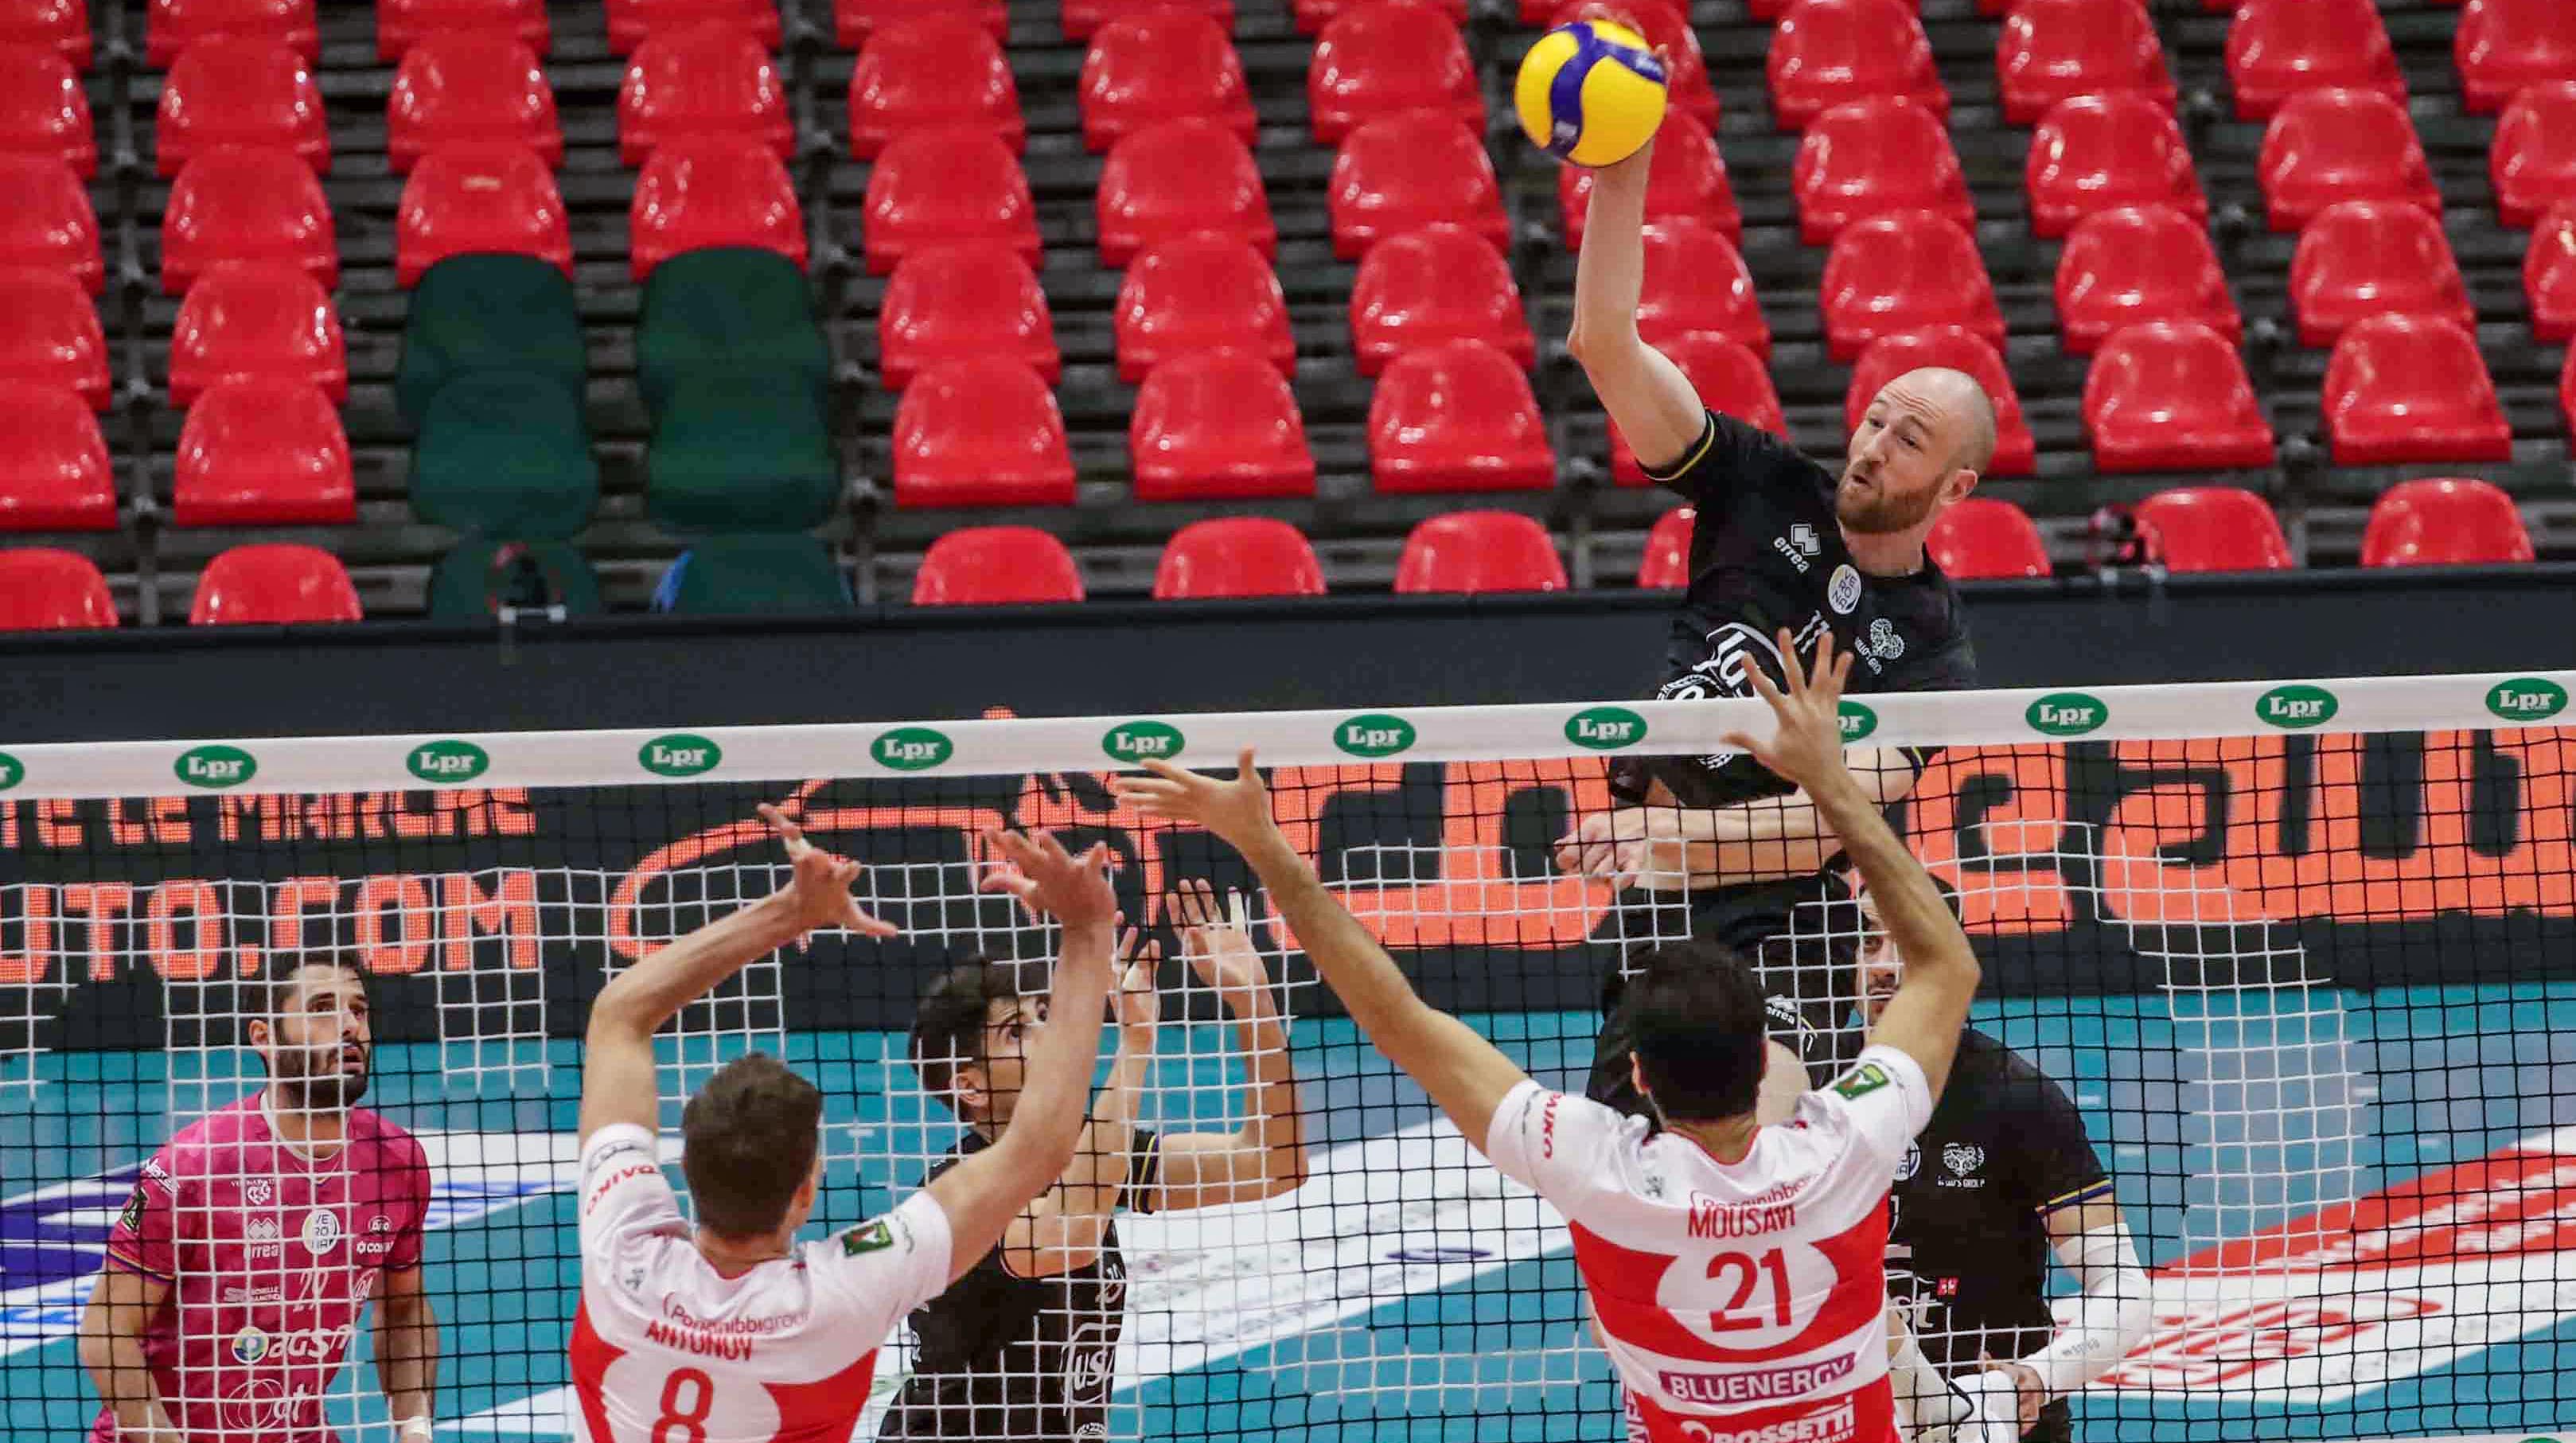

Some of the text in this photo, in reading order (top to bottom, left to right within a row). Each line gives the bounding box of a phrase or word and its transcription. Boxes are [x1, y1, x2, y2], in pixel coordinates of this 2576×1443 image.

[2269, 696, 2324, 719] Lpr
[2499, 689, 2555, 711] Lpr
[1838, 715, 1864, 733] pr
[2040, 704, 2094, 726] Lpr
[1347, 726, 1402, 747] Lpr
[1577, 719, 1633, 740] Lpr
[884, 739, 939, 761] Lpr
[1116, 732, 1171, 755] Lpr
[188, 757, 244, 779] Lpr
[419, 751, 475, 774] Lpr
[653, 746, 707, 768] Lpr
[1688, 1203, 1796, 1238] MOUSAVI
[243, 1242, 279, 1258] rrea
[1705, 1243, 1792, 1332] 21
[1670, 1357, 1851, 1402] BLUENERGY
[651, 1367, 714, 1443] 8
